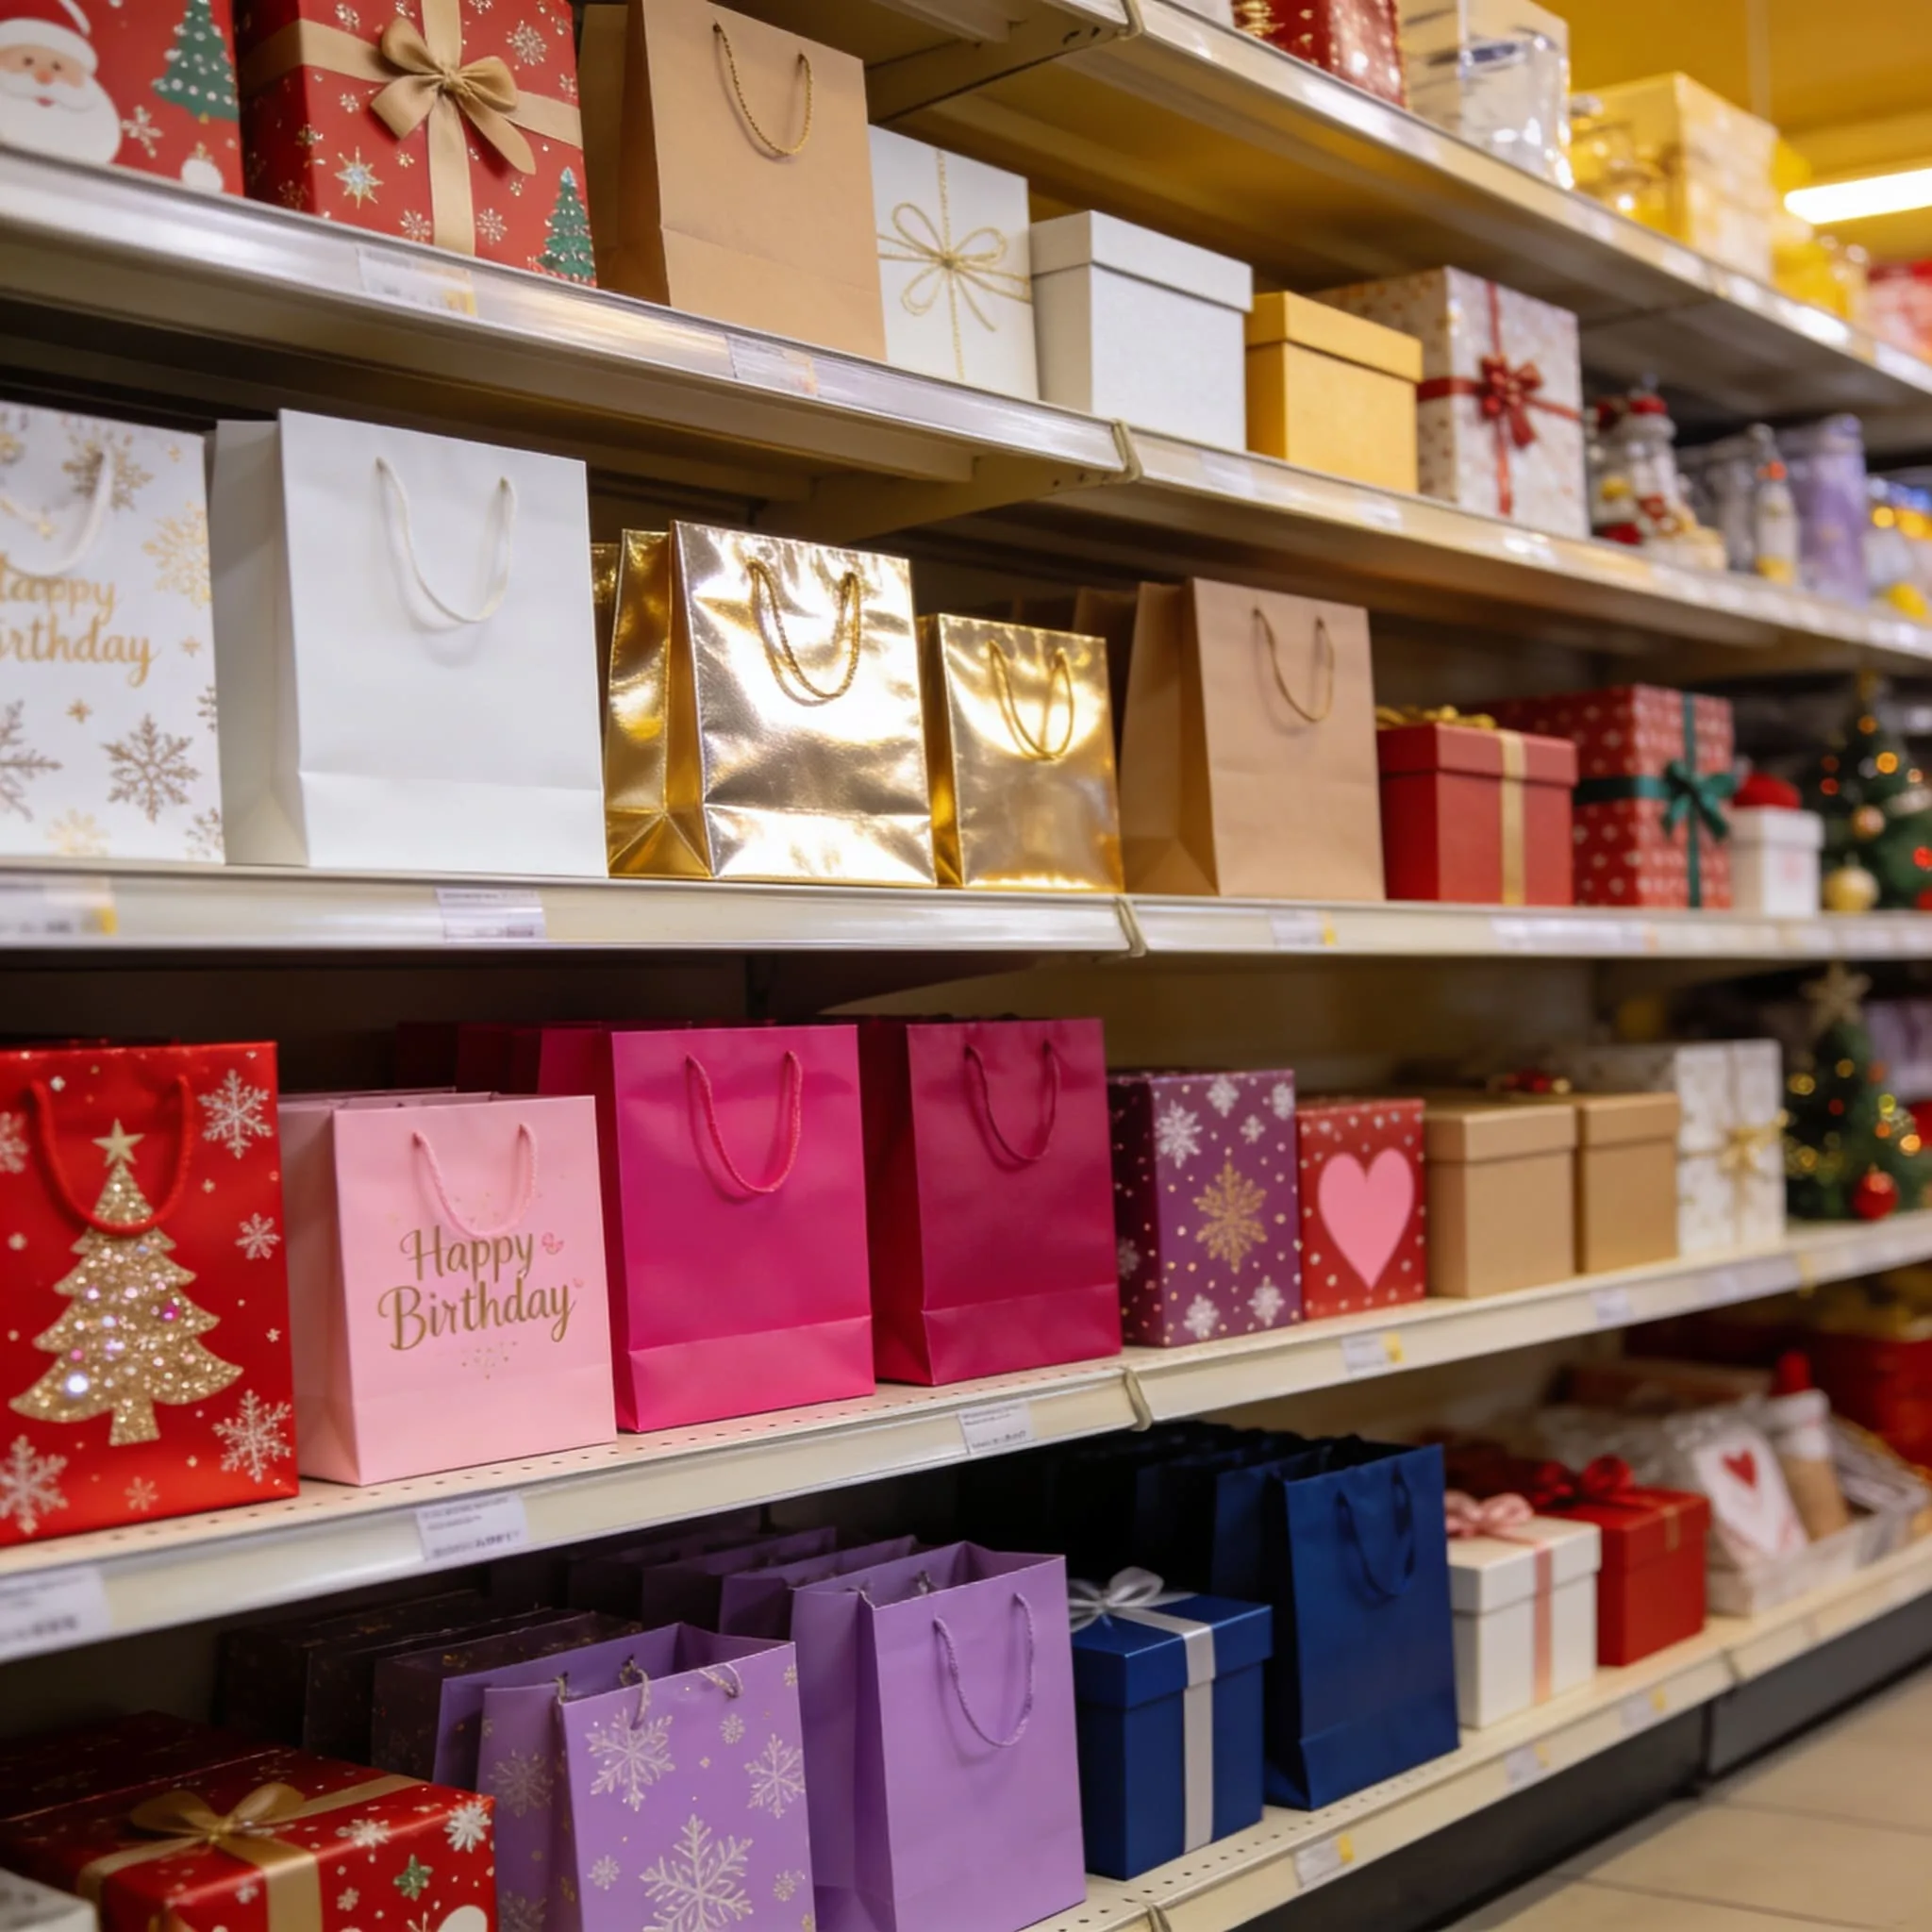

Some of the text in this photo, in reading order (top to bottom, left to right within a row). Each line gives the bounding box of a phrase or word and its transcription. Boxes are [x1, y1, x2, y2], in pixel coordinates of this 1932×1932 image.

[0, 551, 115, 626] appy
[0, 612, 161, 689] rthday
[399, 1224, 534, 1283] Happy
[378, 1277, 576, 1351] Birthday
